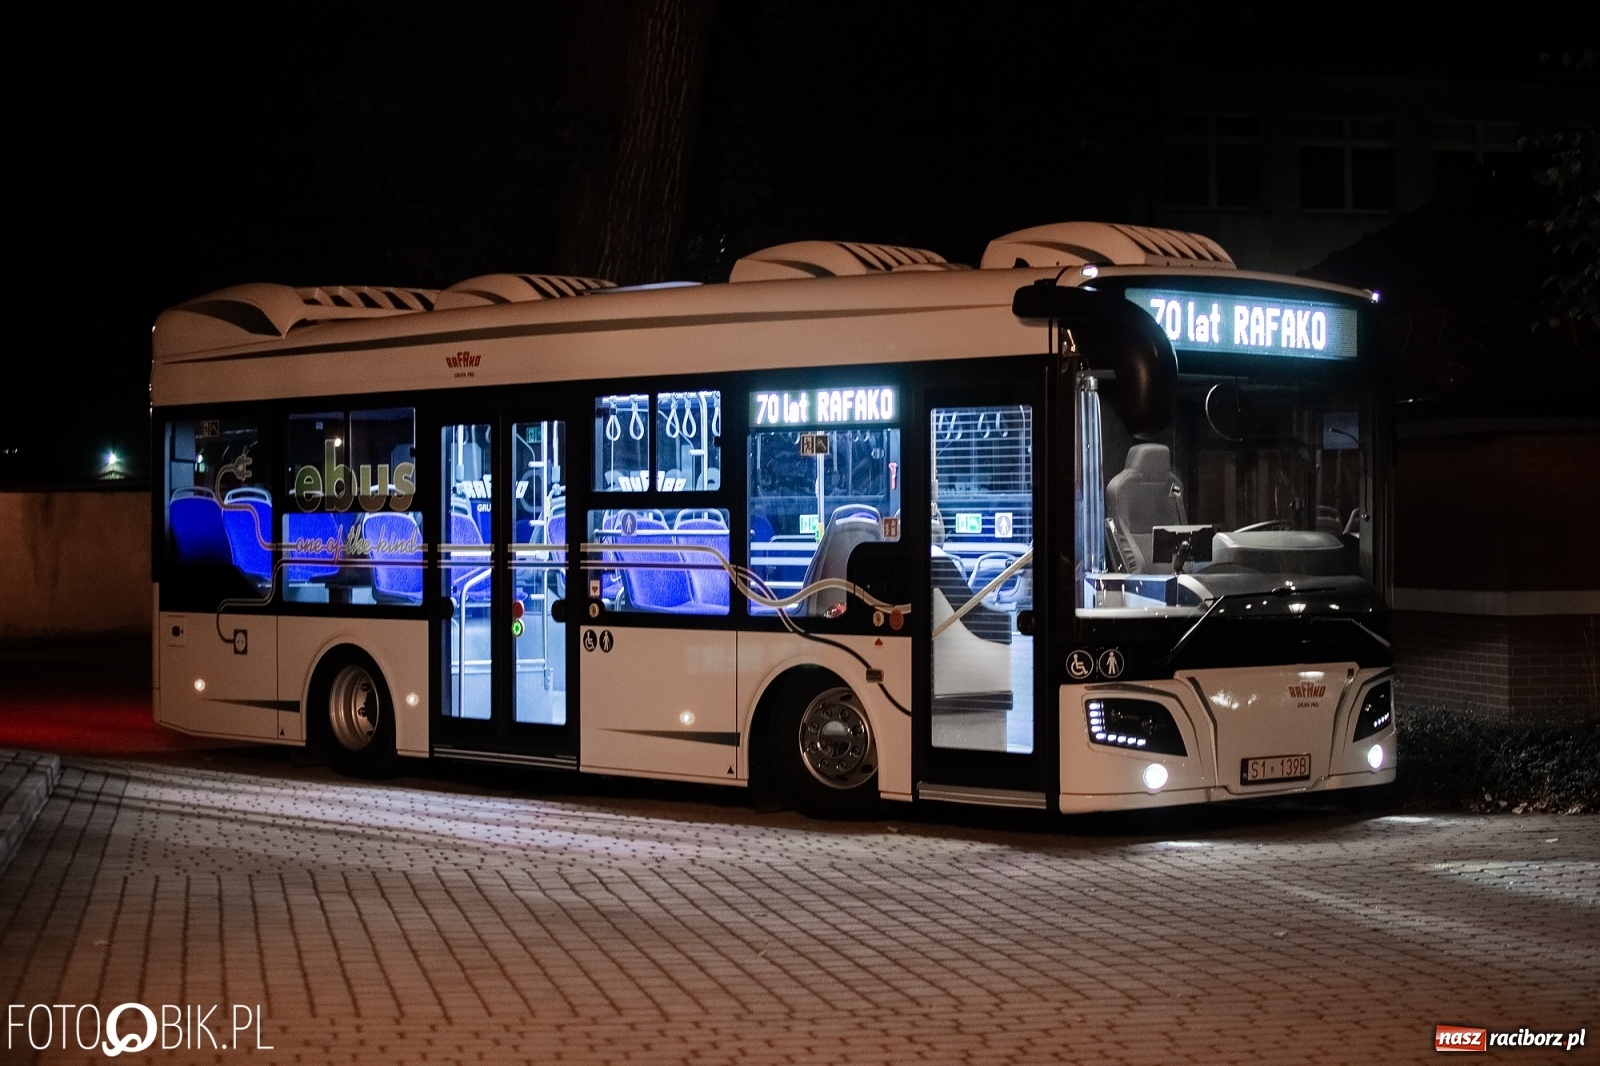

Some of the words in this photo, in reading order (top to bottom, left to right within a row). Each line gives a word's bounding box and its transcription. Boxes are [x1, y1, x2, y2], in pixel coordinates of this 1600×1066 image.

[1150, 298, 1182, 341] 70
[1187, 301, 1220, 343] lat
[1233, 305, 1327, 350] RAFAKO
[445, 351, 482, 369] RAFAKO
[756, 393, 780, 425] 70
[783, 392, 808, 424] lat
[816, 388, 893, 422] RAFAKO
[294, 438, 416, 513] ebus
[296, 537, 323, 554] one
[326, 523, 344, 564] of
[344, 523, 371, 556] the
[375, 524, 418, 554] kind
[1288, 681, 1326, 698] RAFAKO
[1251, 760, 1266, 779] S1
[1280, 757, 1306, 777] 139B
